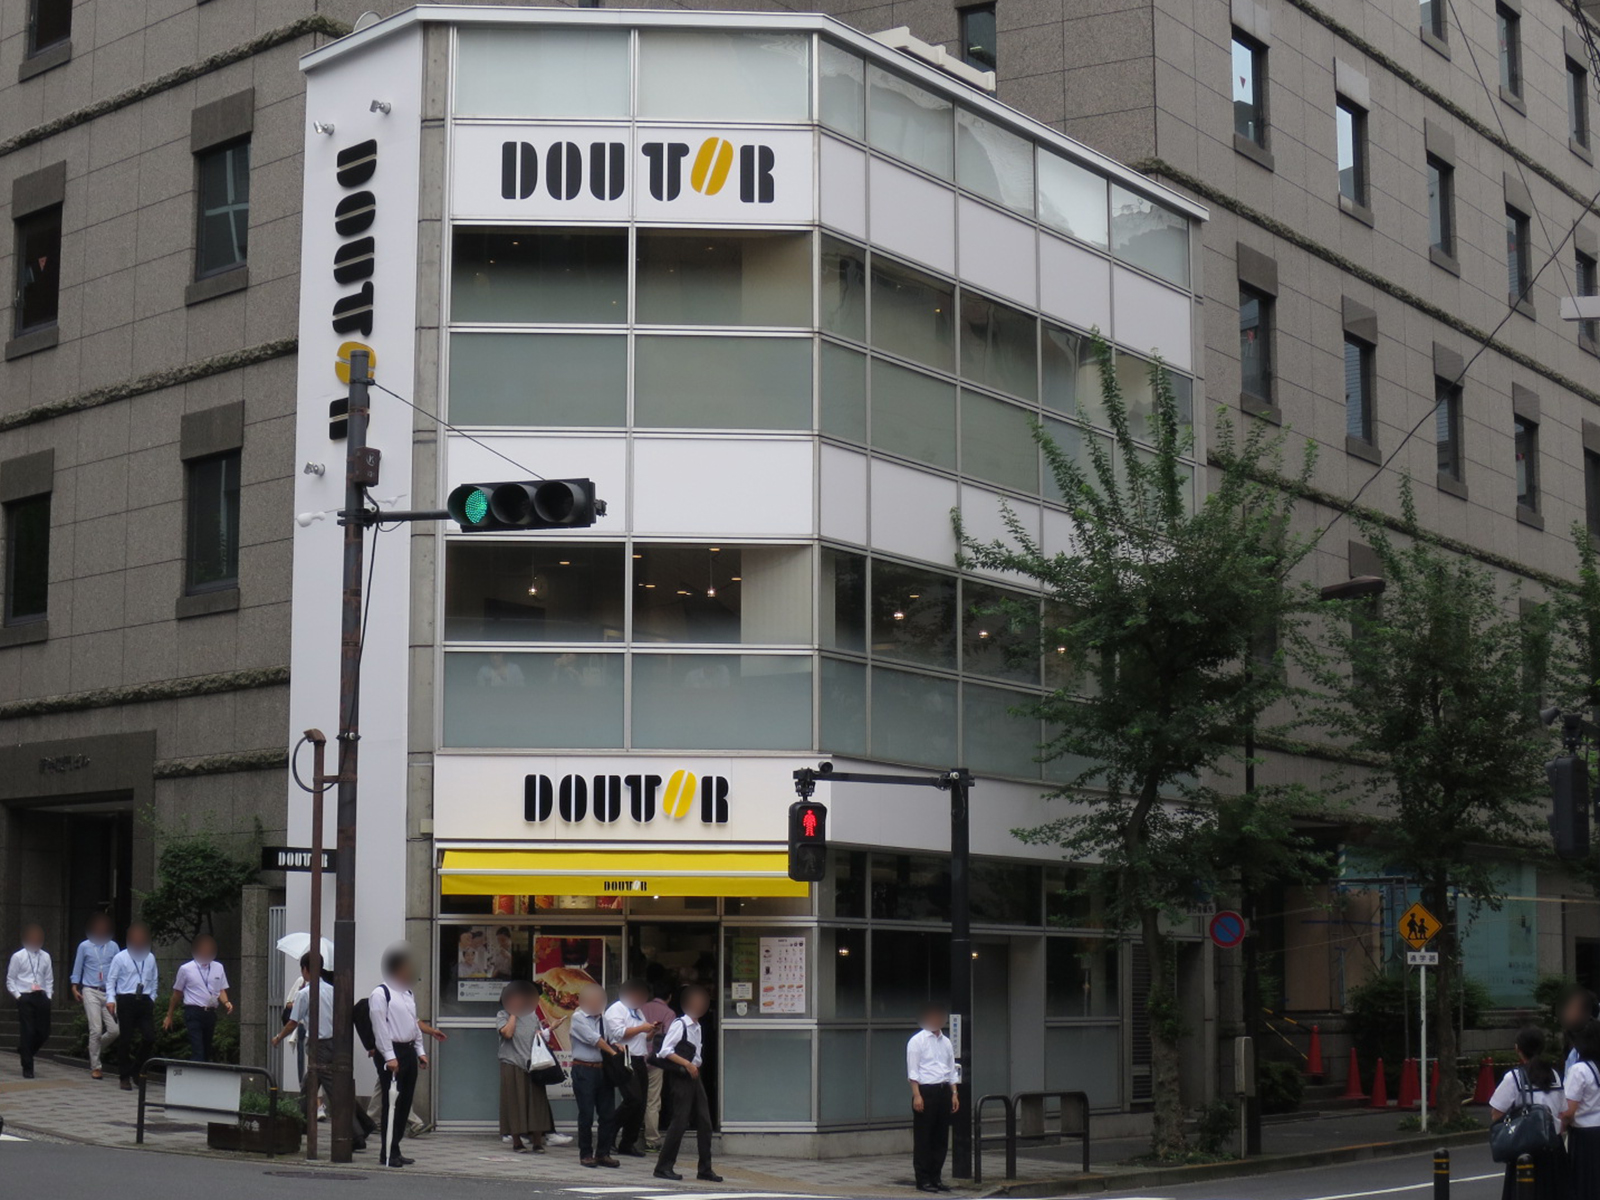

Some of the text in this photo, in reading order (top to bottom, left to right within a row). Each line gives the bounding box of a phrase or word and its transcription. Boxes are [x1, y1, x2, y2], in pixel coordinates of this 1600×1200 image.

[501, 137, 775, 203] DOUTOR
[524, 769, 729, 823] DOUTOR
[278, 852, 328, 868] DOUTR
[604, 880, 647, 891] DOUTOR
[1410, 954, 1436, 963] 通学路
